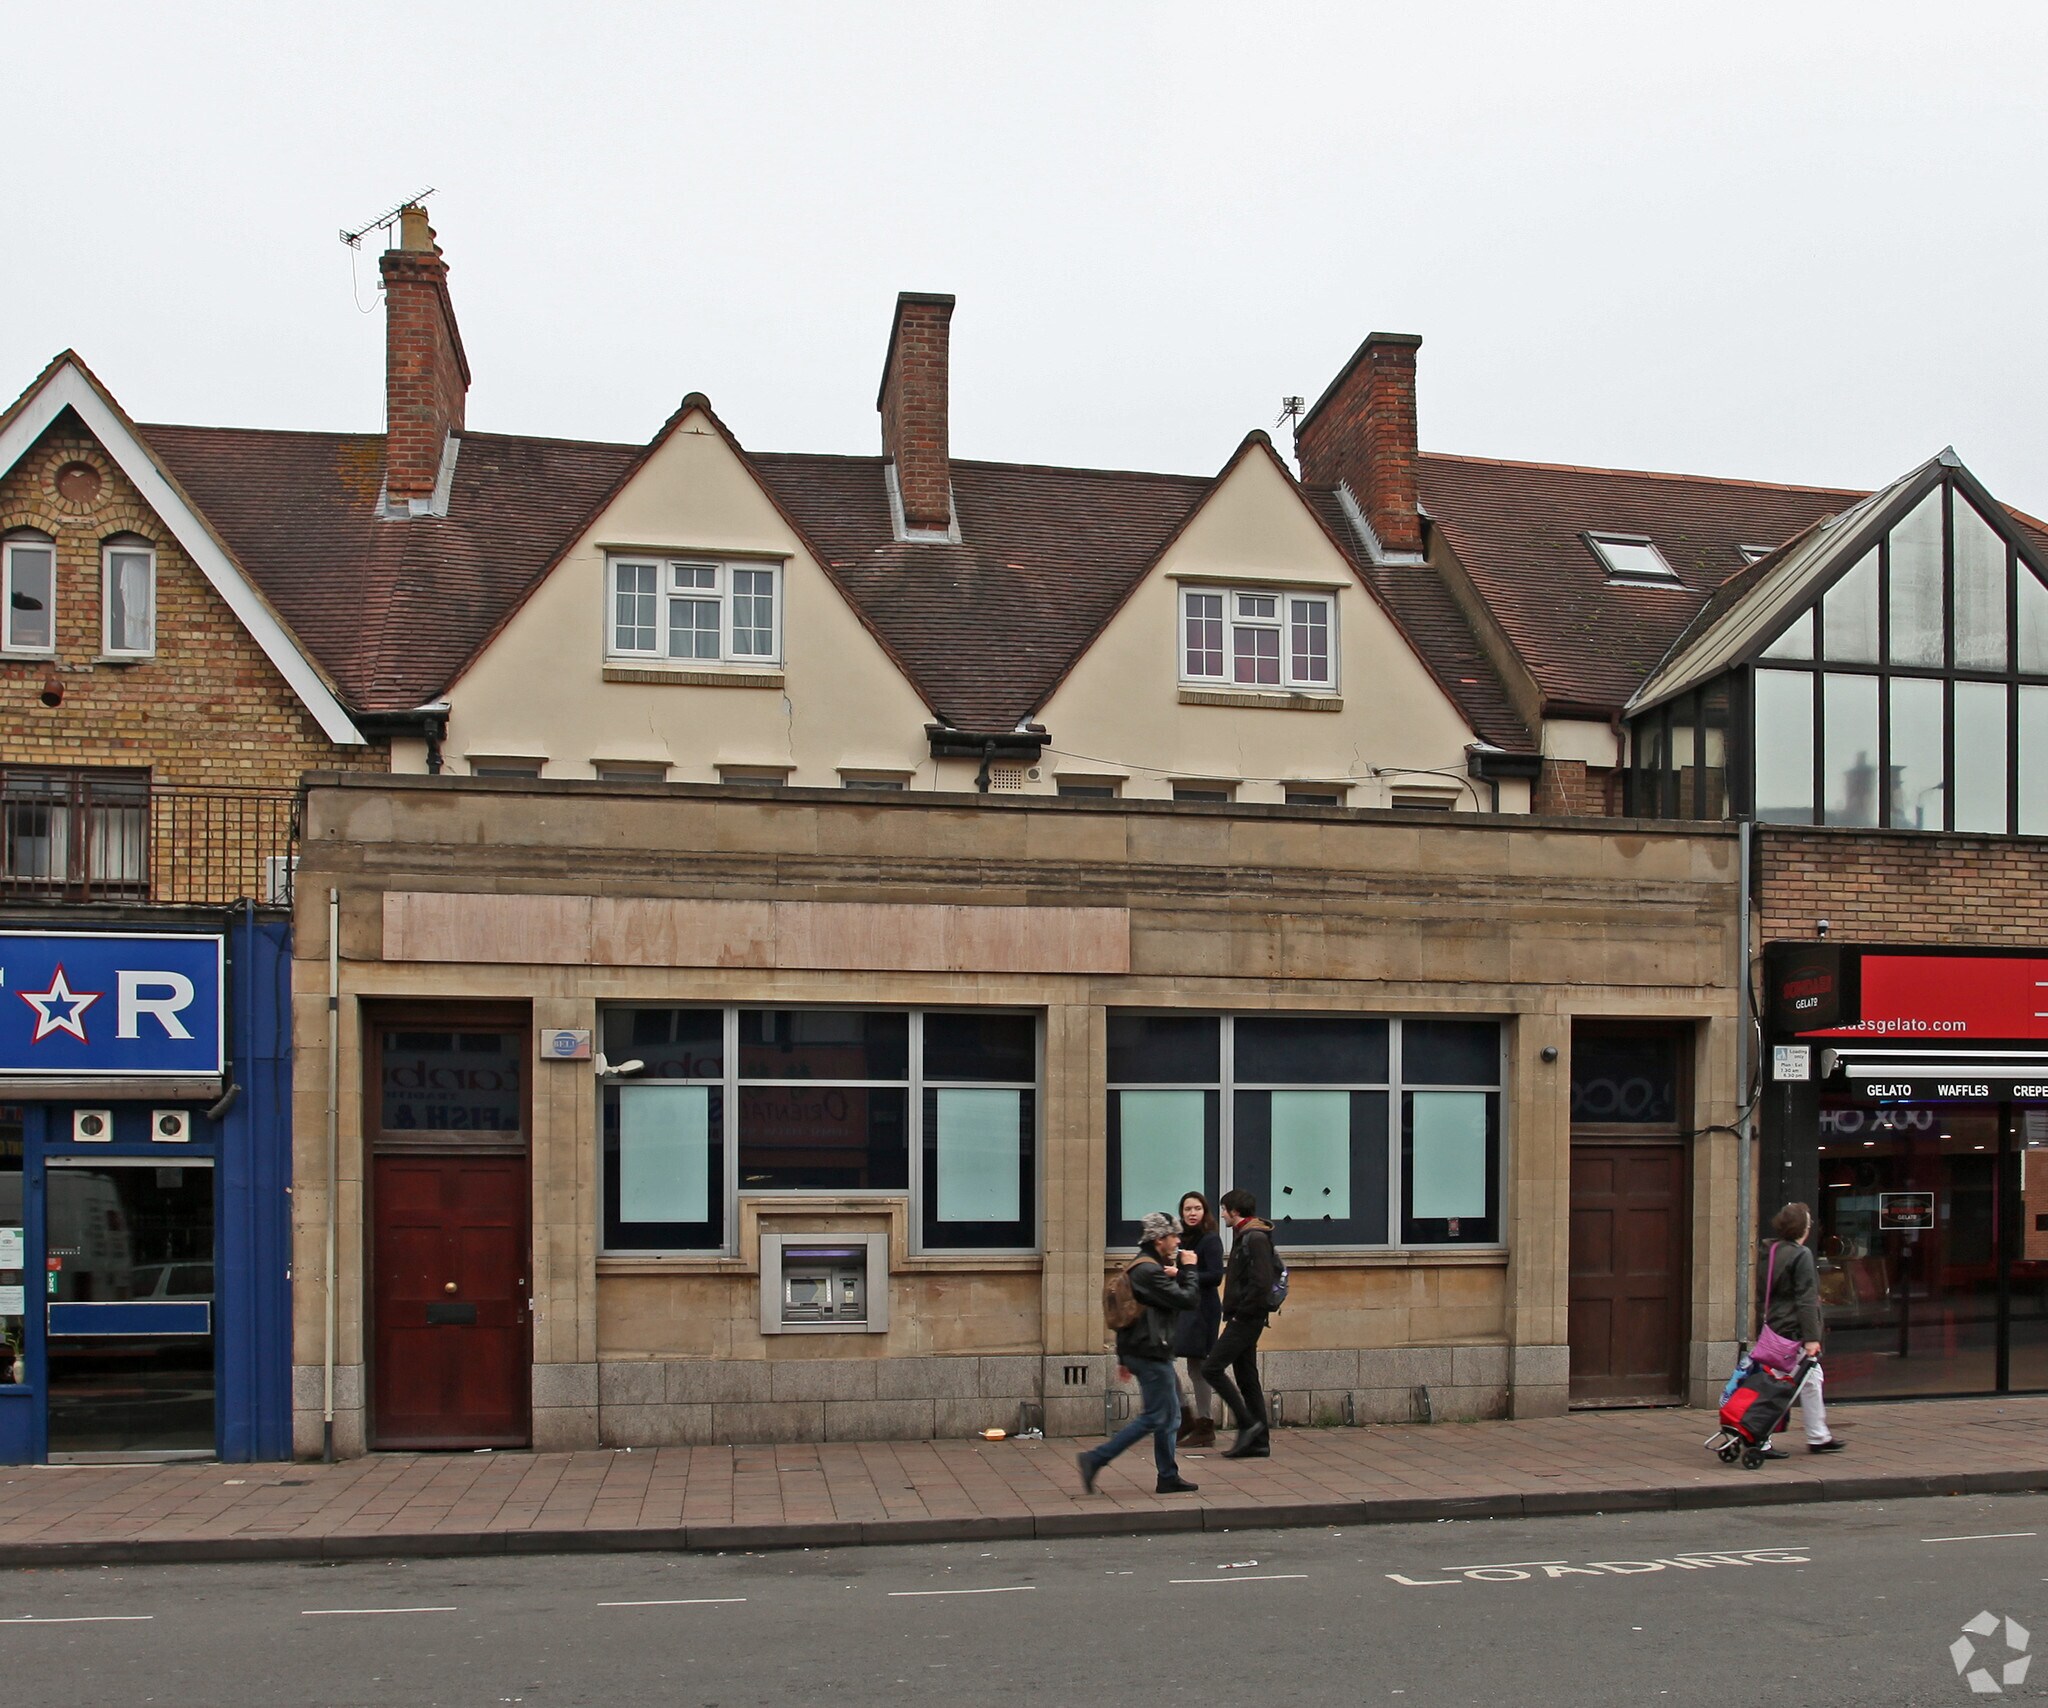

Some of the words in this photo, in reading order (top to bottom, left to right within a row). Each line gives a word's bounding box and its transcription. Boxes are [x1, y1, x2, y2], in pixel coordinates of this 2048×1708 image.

[1795, 997, 1818, 1010] GELATO
[1866, 1084, 1912, 1097] GELATO
[1937, 1084, 1989, 1097] WAFFLES
[1385, 1551, 1811, 1586] LOADING
